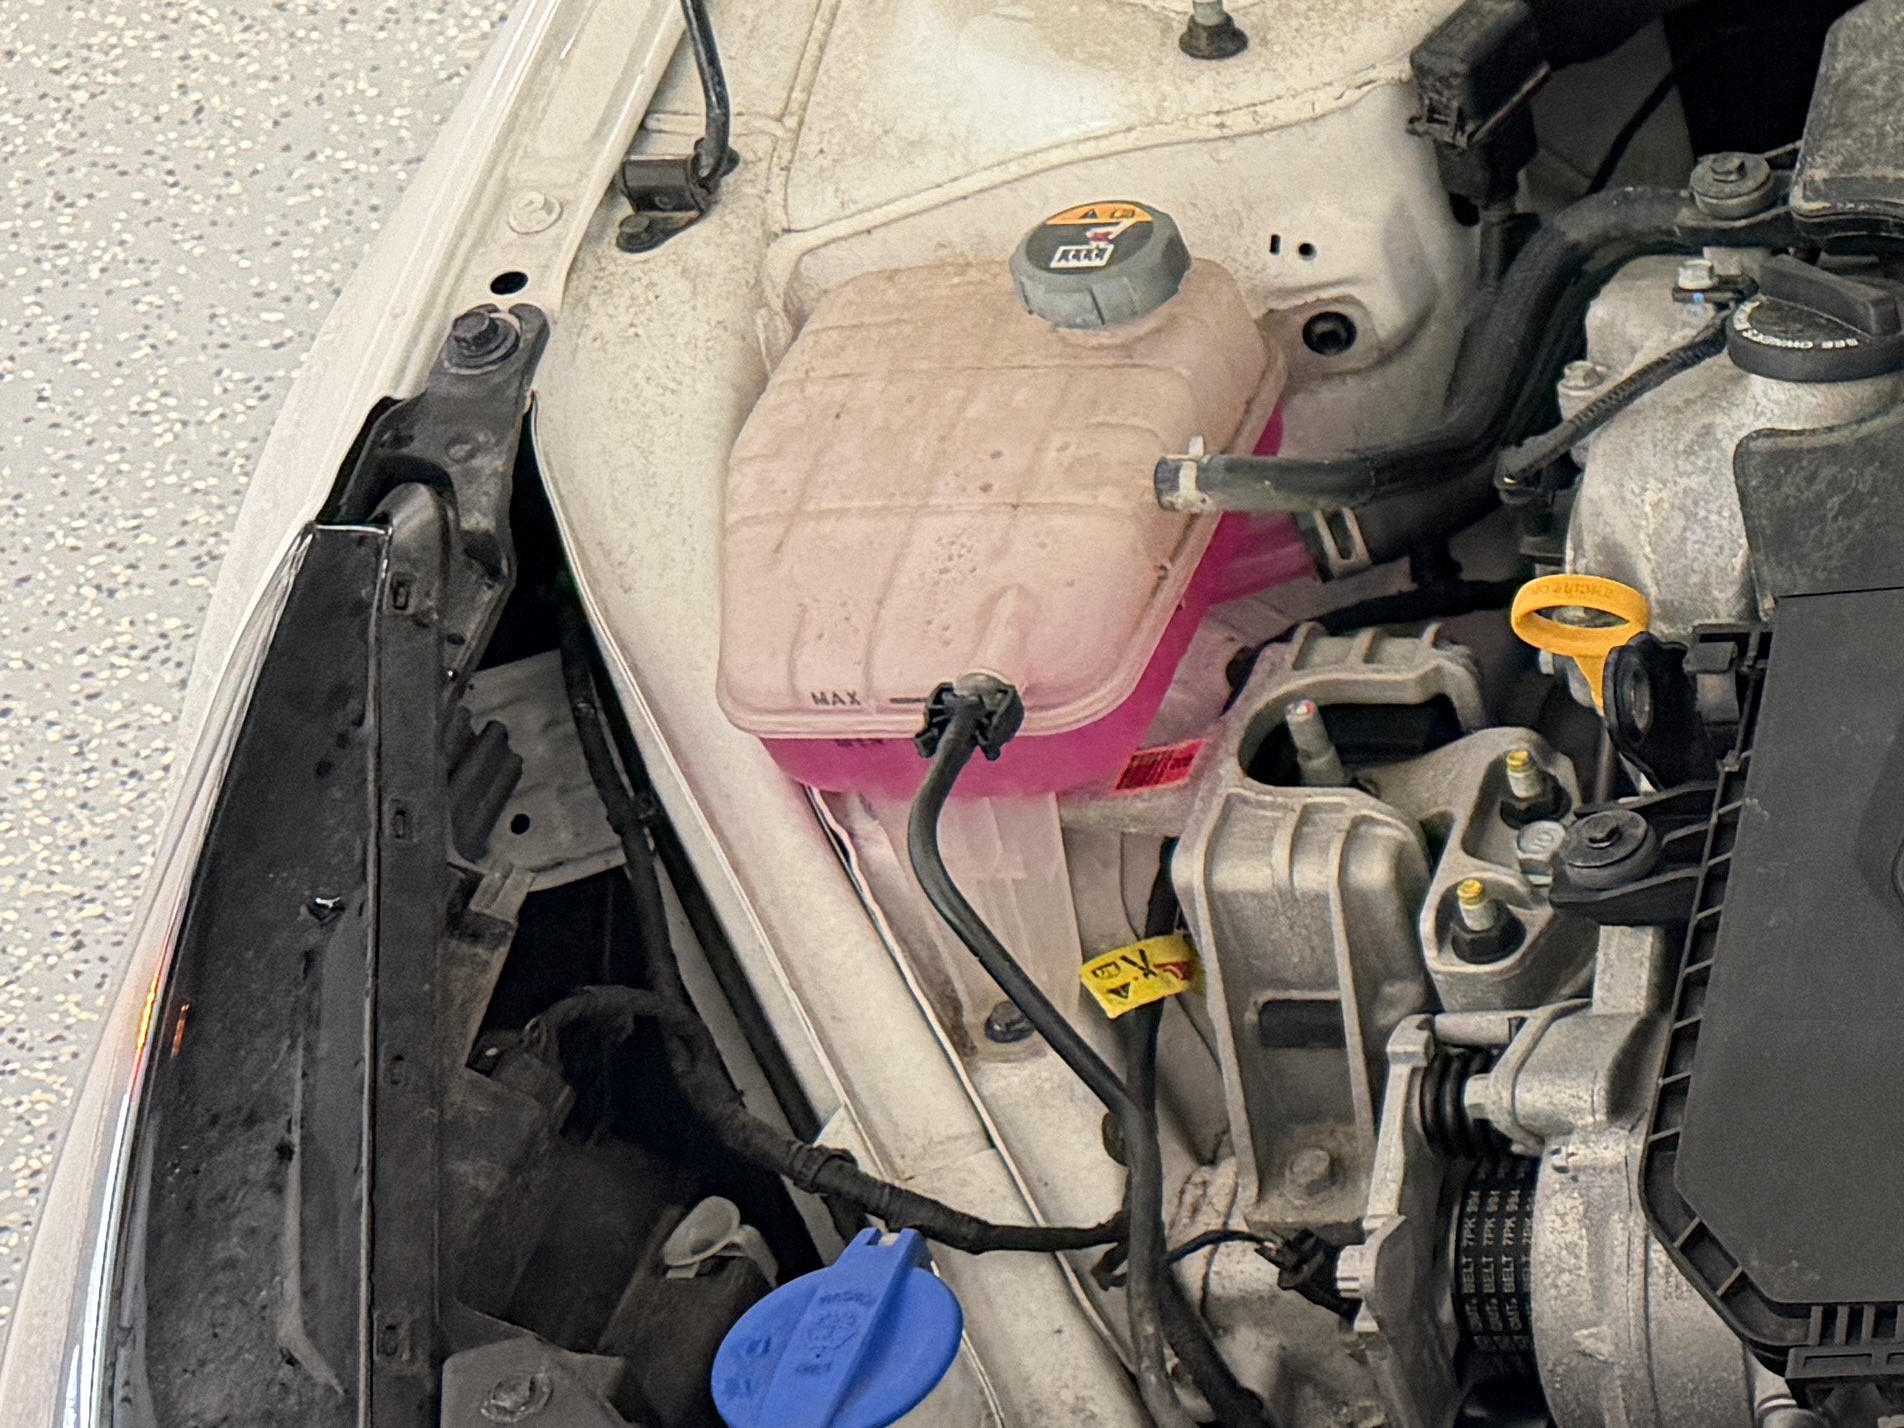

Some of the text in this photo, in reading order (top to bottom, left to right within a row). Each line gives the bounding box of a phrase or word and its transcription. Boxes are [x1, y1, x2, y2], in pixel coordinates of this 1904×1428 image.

[811, 691, 861, 706] MAX
[1462, 1256, 1476, 1293] BELT
[1482, 1256, 1496, 1293] BELT
[1502, 1255, 1516, 1293] BELT
